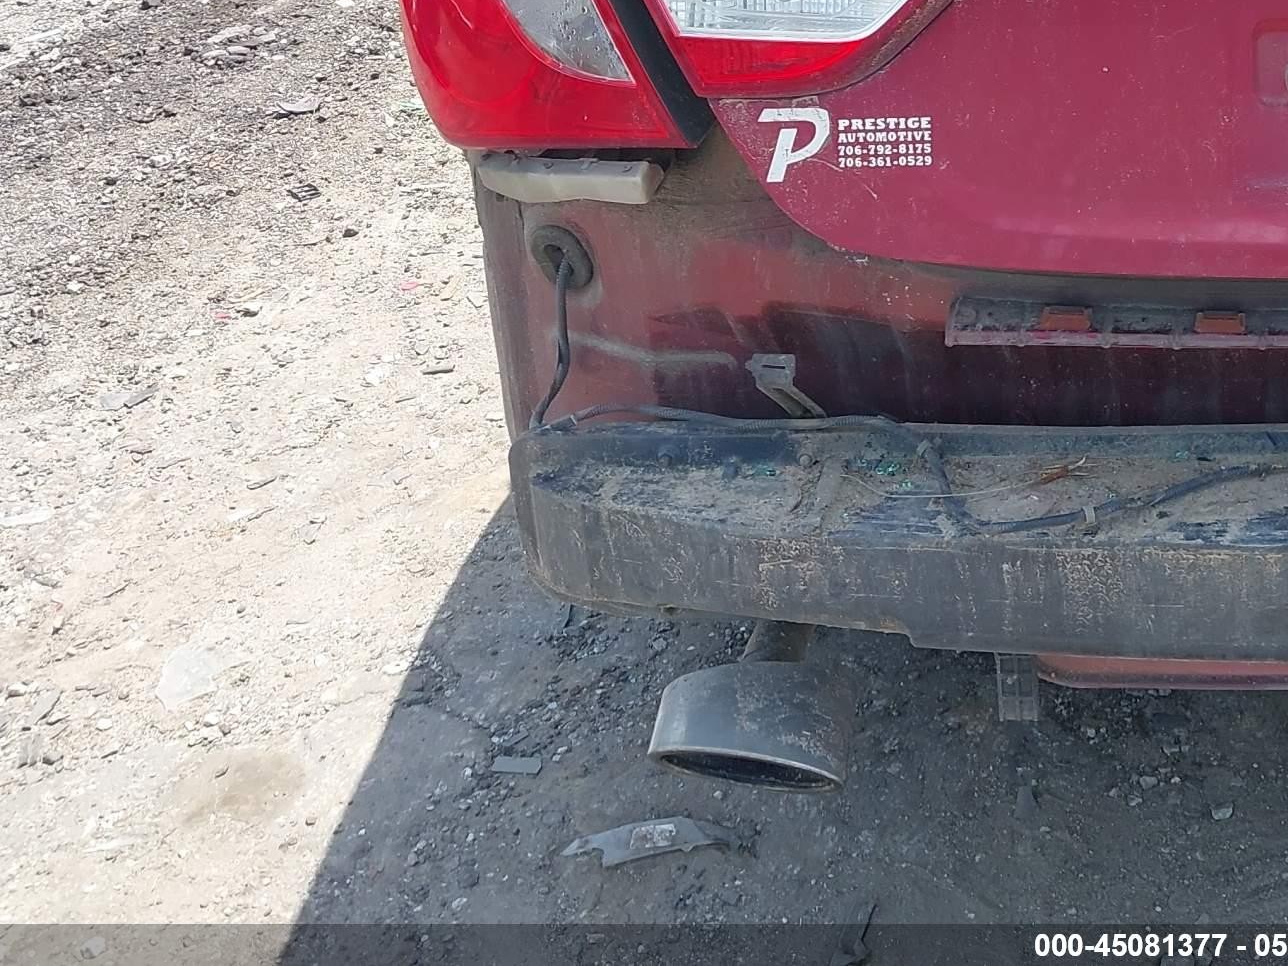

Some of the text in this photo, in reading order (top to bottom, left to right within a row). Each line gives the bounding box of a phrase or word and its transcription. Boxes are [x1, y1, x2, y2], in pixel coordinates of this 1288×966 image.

[837, 116, 932, 131] PRESTIGE
[837, 130, 932, 143] AUTOMOTIVE
[757, 107, 831, 183] P
[837, 143, 932, 156] 706-792-8175
[837, 155, 932, 168] 706-361-0529
